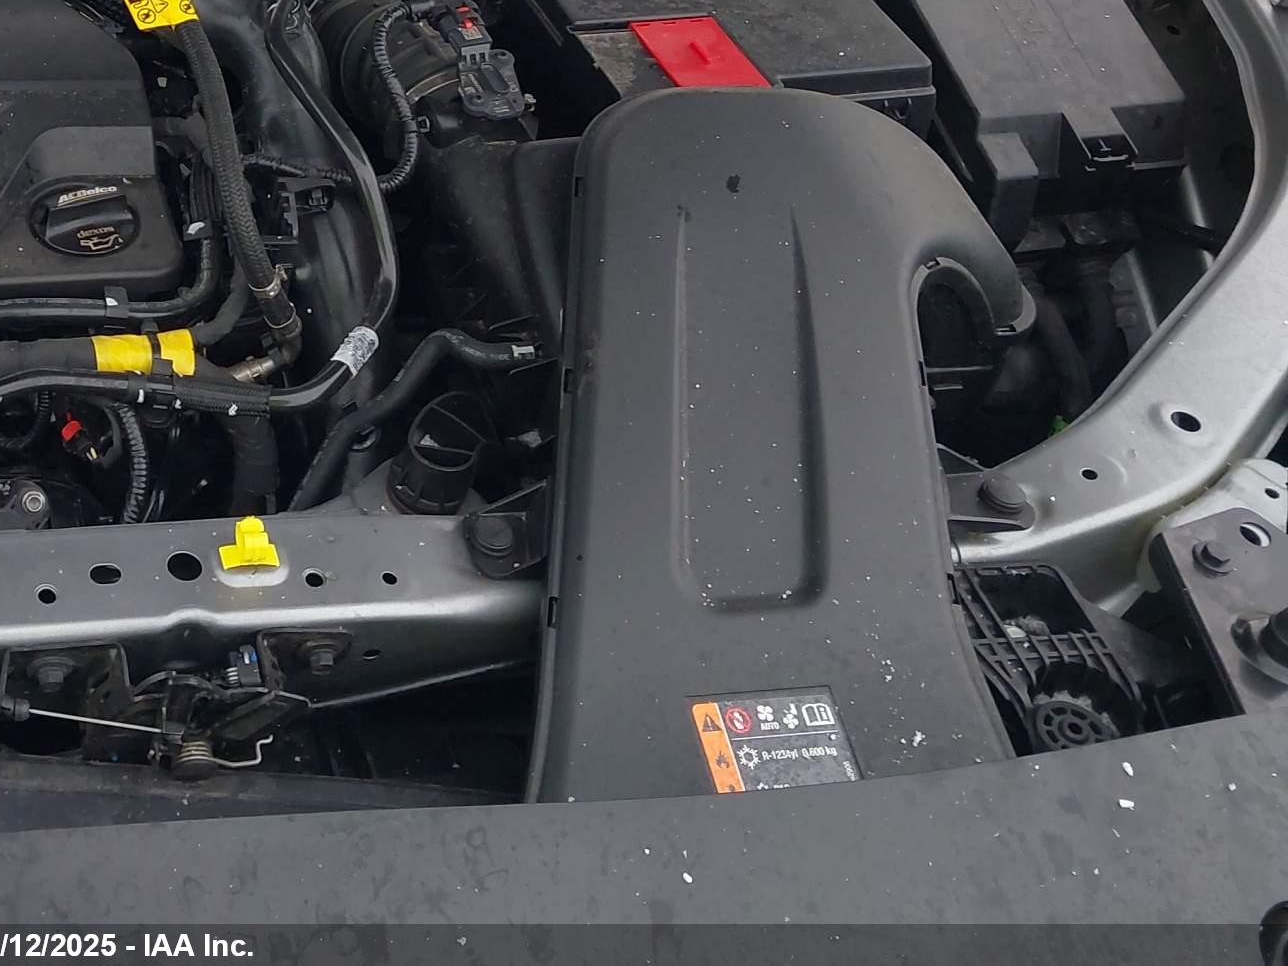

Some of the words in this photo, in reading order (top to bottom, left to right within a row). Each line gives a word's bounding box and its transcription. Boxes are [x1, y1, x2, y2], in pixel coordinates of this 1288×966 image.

[58, 186, 117, 203] ACDelco
[77, 226, 115, 238] dexos
[760, 722, 780, 731] AUTO
[826, 745, 838, 757] kg
